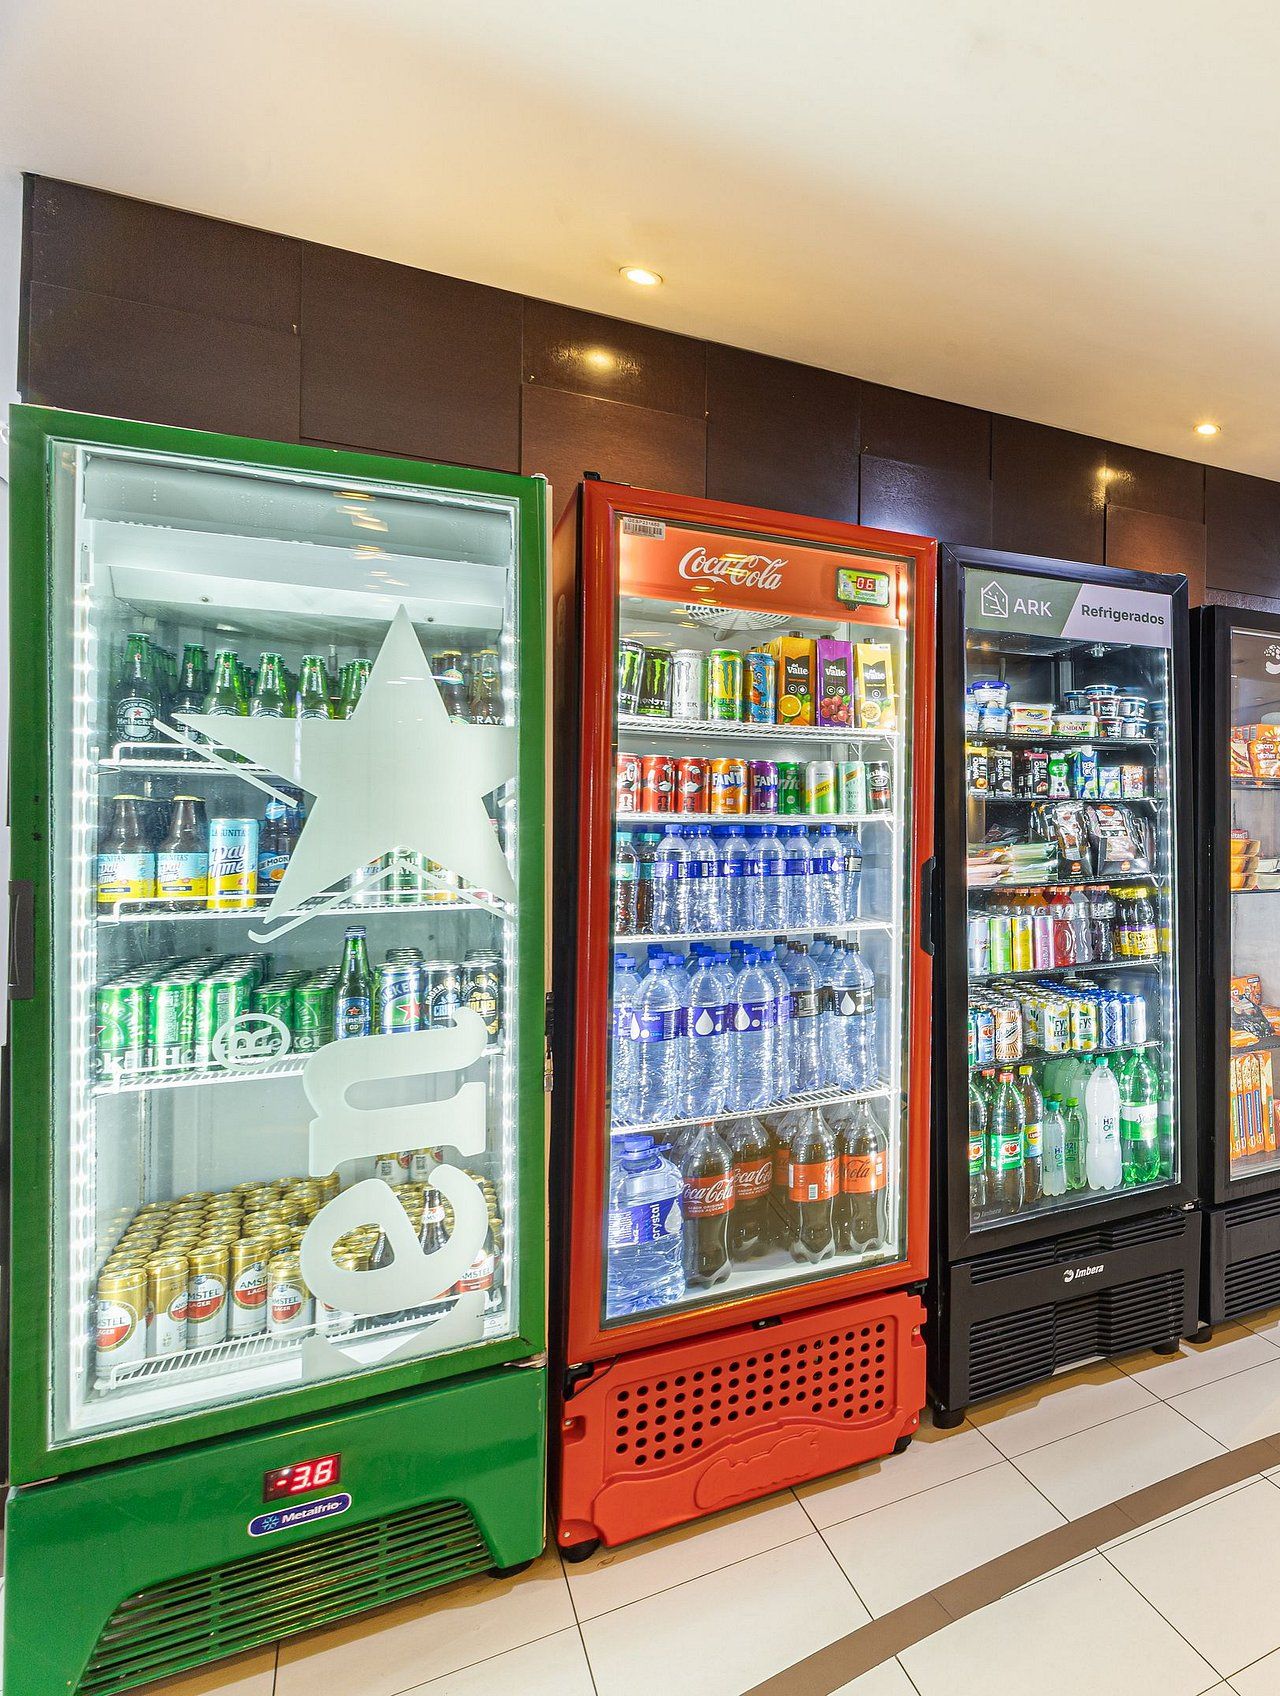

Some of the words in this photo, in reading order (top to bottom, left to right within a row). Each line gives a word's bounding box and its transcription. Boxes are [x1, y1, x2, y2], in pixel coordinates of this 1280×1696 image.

[678, 546, 789, 590] Coca-Cola
[1013, 598, 1053, 618] ARK
[1081, 604, 1165, 635] Refrigerados
[787, 666, 808, 675] Valle
[825, 668, 847, 677] Valle
[117, 717, 154, 725] Heineke
[712, 772, 742, 787] FANT
[754, 775, 779, 788] FANT
[650, 1203, 661, 1240] crystal
[1075, 1264, 1105, 1279] Imbera
[281, 1502, 339, 1523] Metalfrio
